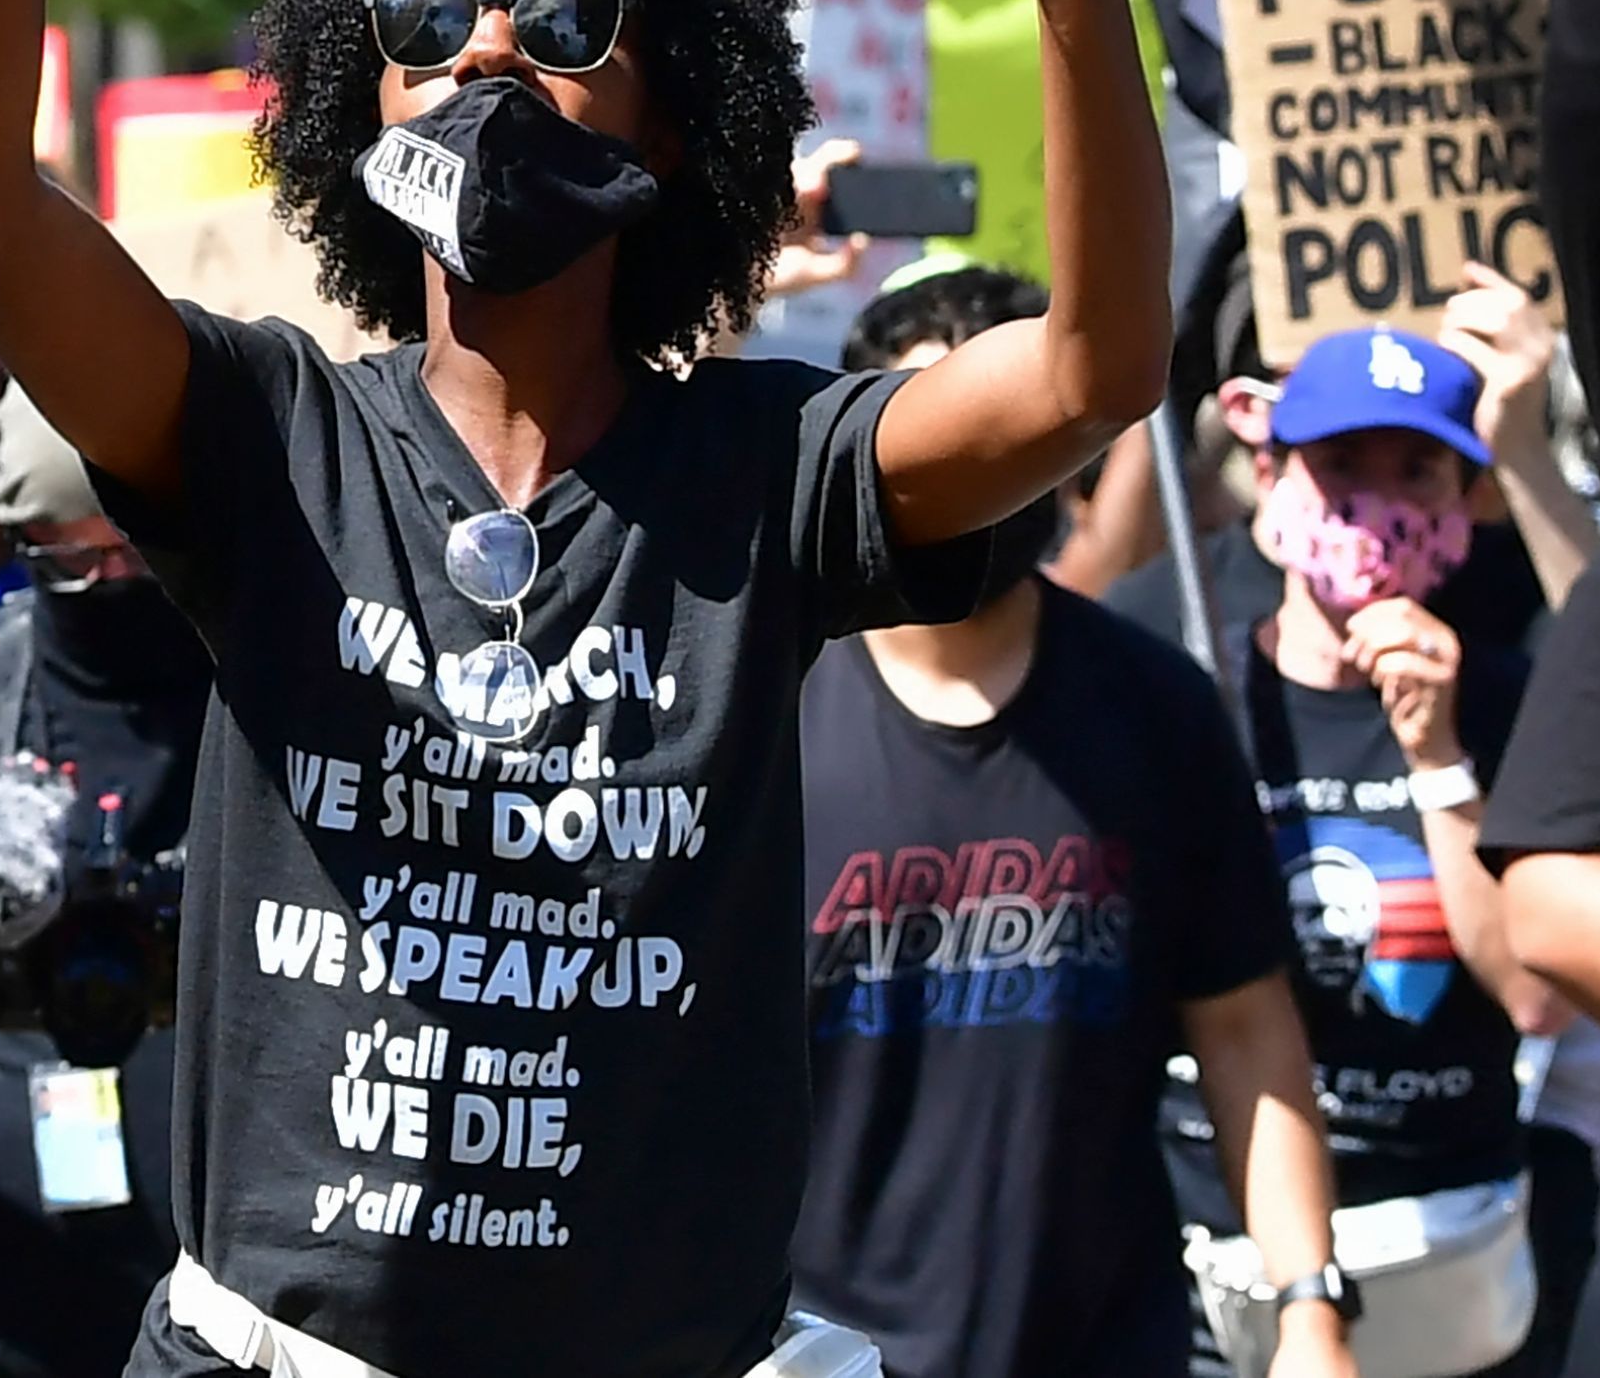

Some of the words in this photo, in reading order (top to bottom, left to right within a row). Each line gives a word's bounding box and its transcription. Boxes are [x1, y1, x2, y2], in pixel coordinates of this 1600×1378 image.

[375, 138, 455, 203] BLACK
[1275, 140, 1403, 215] NOT
[337, 596, 427, 688] WE
[381, 716, 488, 781] y'all
[498, 724, 616, 784] mad.
[286, 746, 363, 832] WE
[380, 773, 470, 848] SIT
[492, 785, 708, 862] DOWN,
[358, 864, 478, 924] y'all
[490, 887, 615, 940] mad.
[812, 834, 1131, 934] ADIDAS
[255, 899, 348, 988] WE
[358, 921, 594, 1011] SPEAK
[590, 936, 697, 1018] UP,
[810, 892, 1130, 983] ADIDAS
[345, 1018, 449, 1080] y'all
[462, 1035, 580, 1087] mad.
[1335, 1066, 1473, 1101] FLOYD
[331, 1075, 429, 1160] WE
[450, 1092, 582, 1177] DIE,
[311, 1174, 423, 1236] y'all
[428, 1193, 569, 1247] silent.
